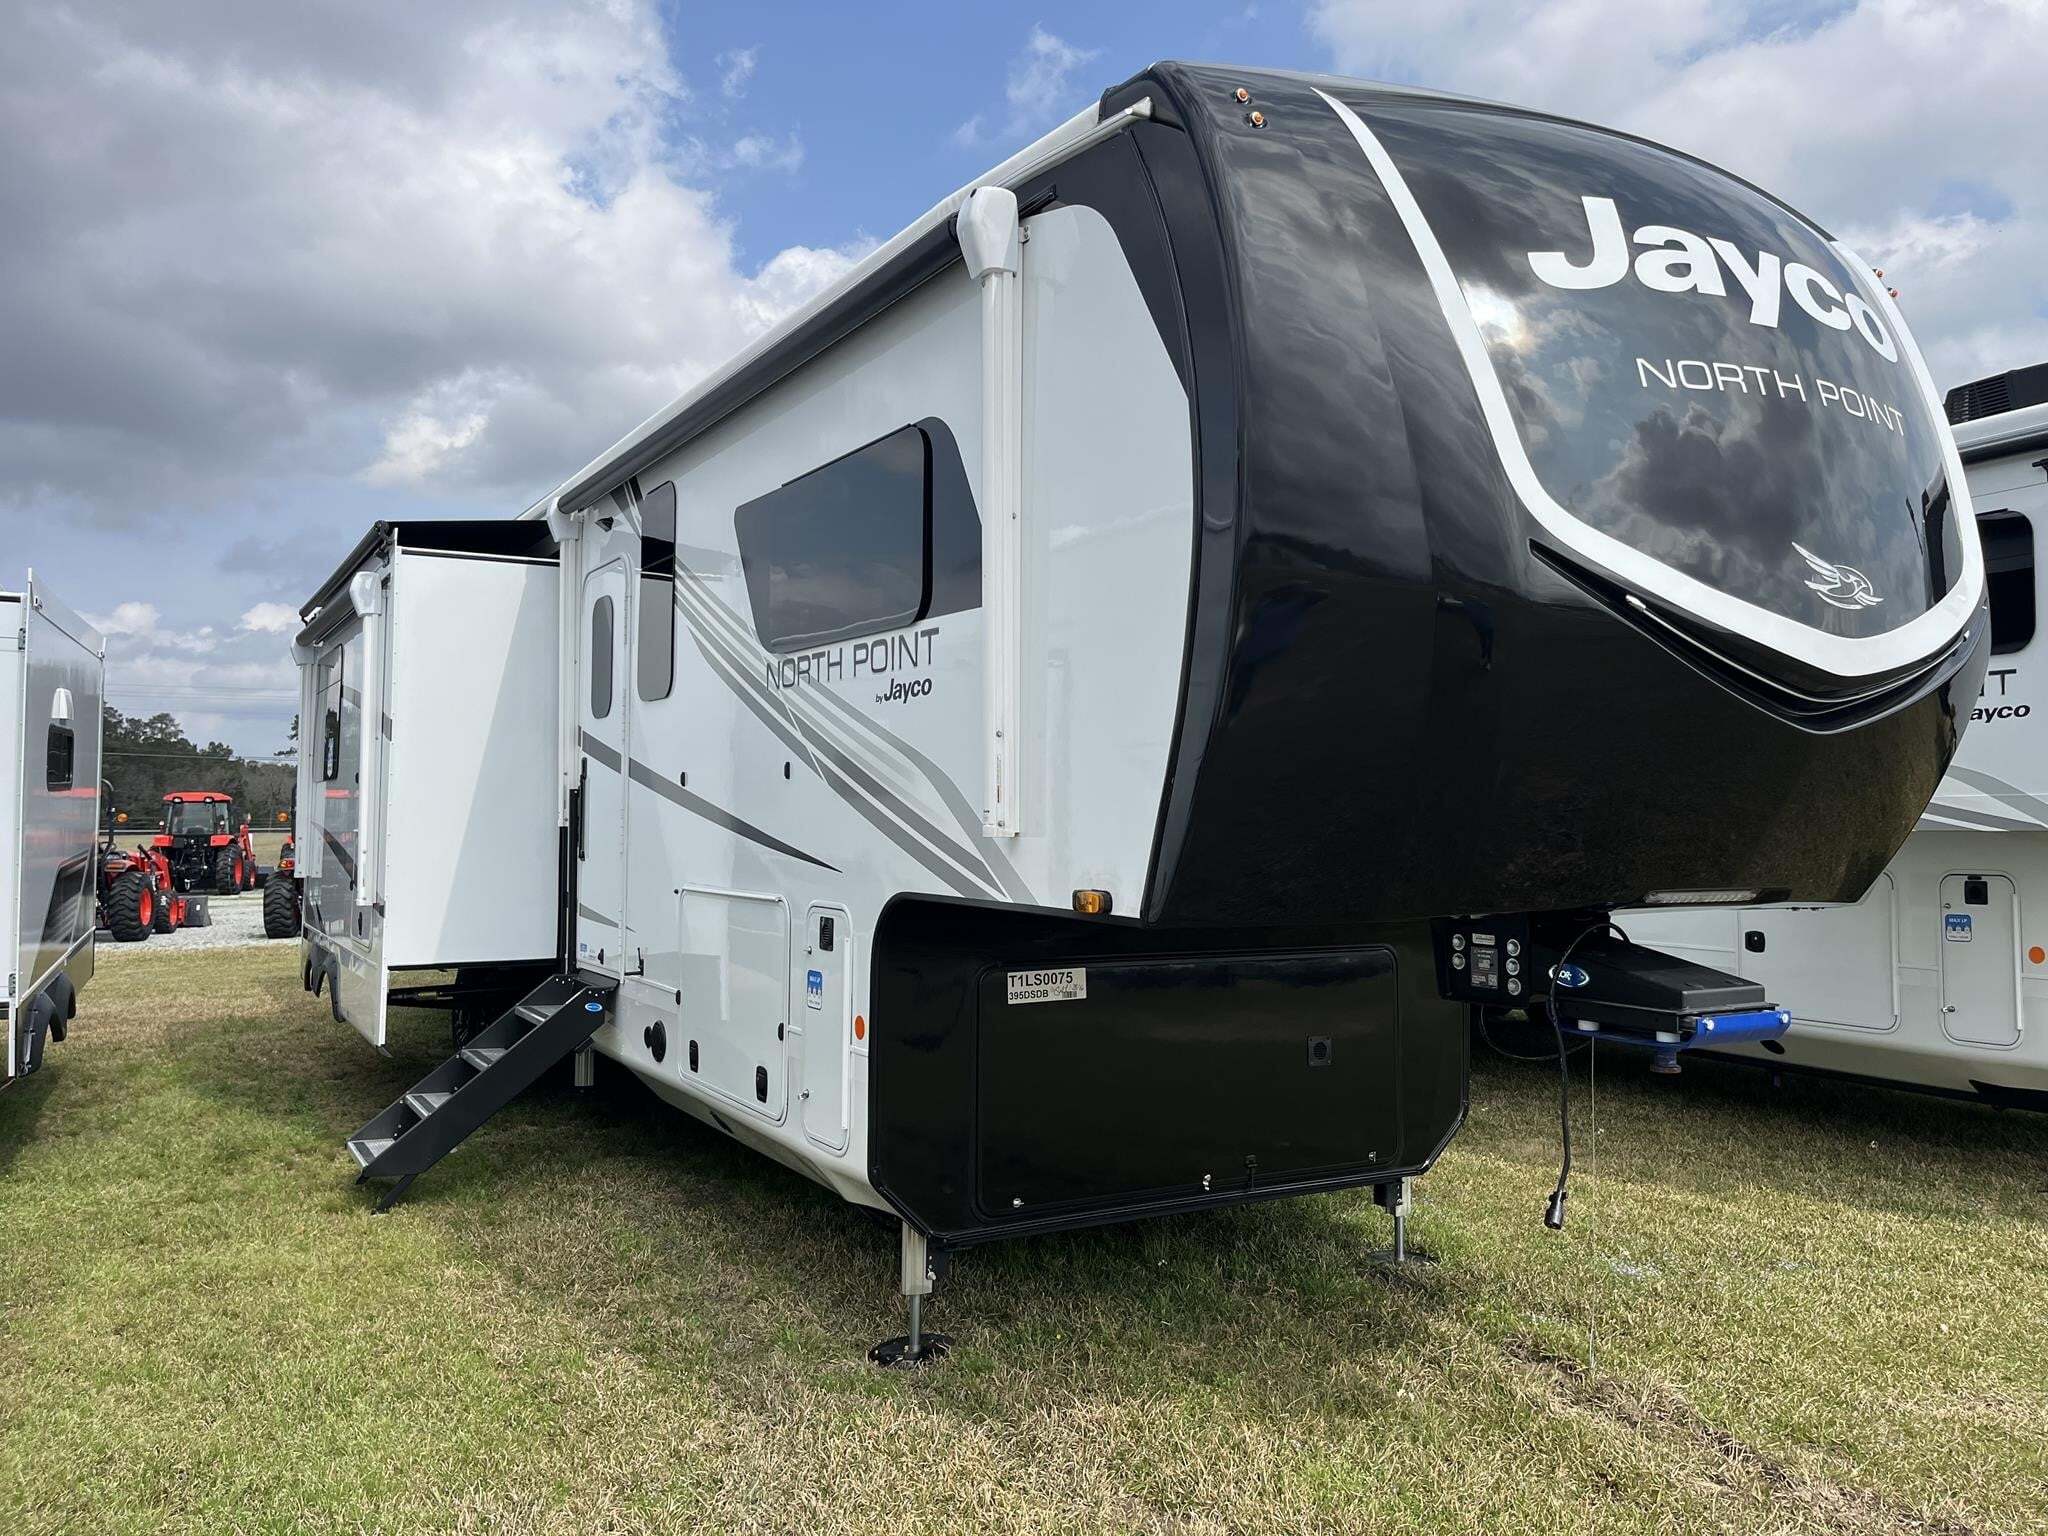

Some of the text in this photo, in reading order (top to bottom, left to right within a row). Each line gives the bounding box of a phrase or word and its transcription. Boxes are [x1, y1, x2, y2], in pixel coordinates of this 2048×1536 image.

[1527, 195, 1898, 362] Jayco
[1636, 357, 1906, 436] NORTH POINT
[767, 627, 940, 691] NORTH POINT
[875, 678, 933, 704] by Jayco
[1970, 704, 2031, 724] ayco
[1009, 972, 1073, 987] T1LS0075
[1009, 989, 1049, 1000] 395DSDB
